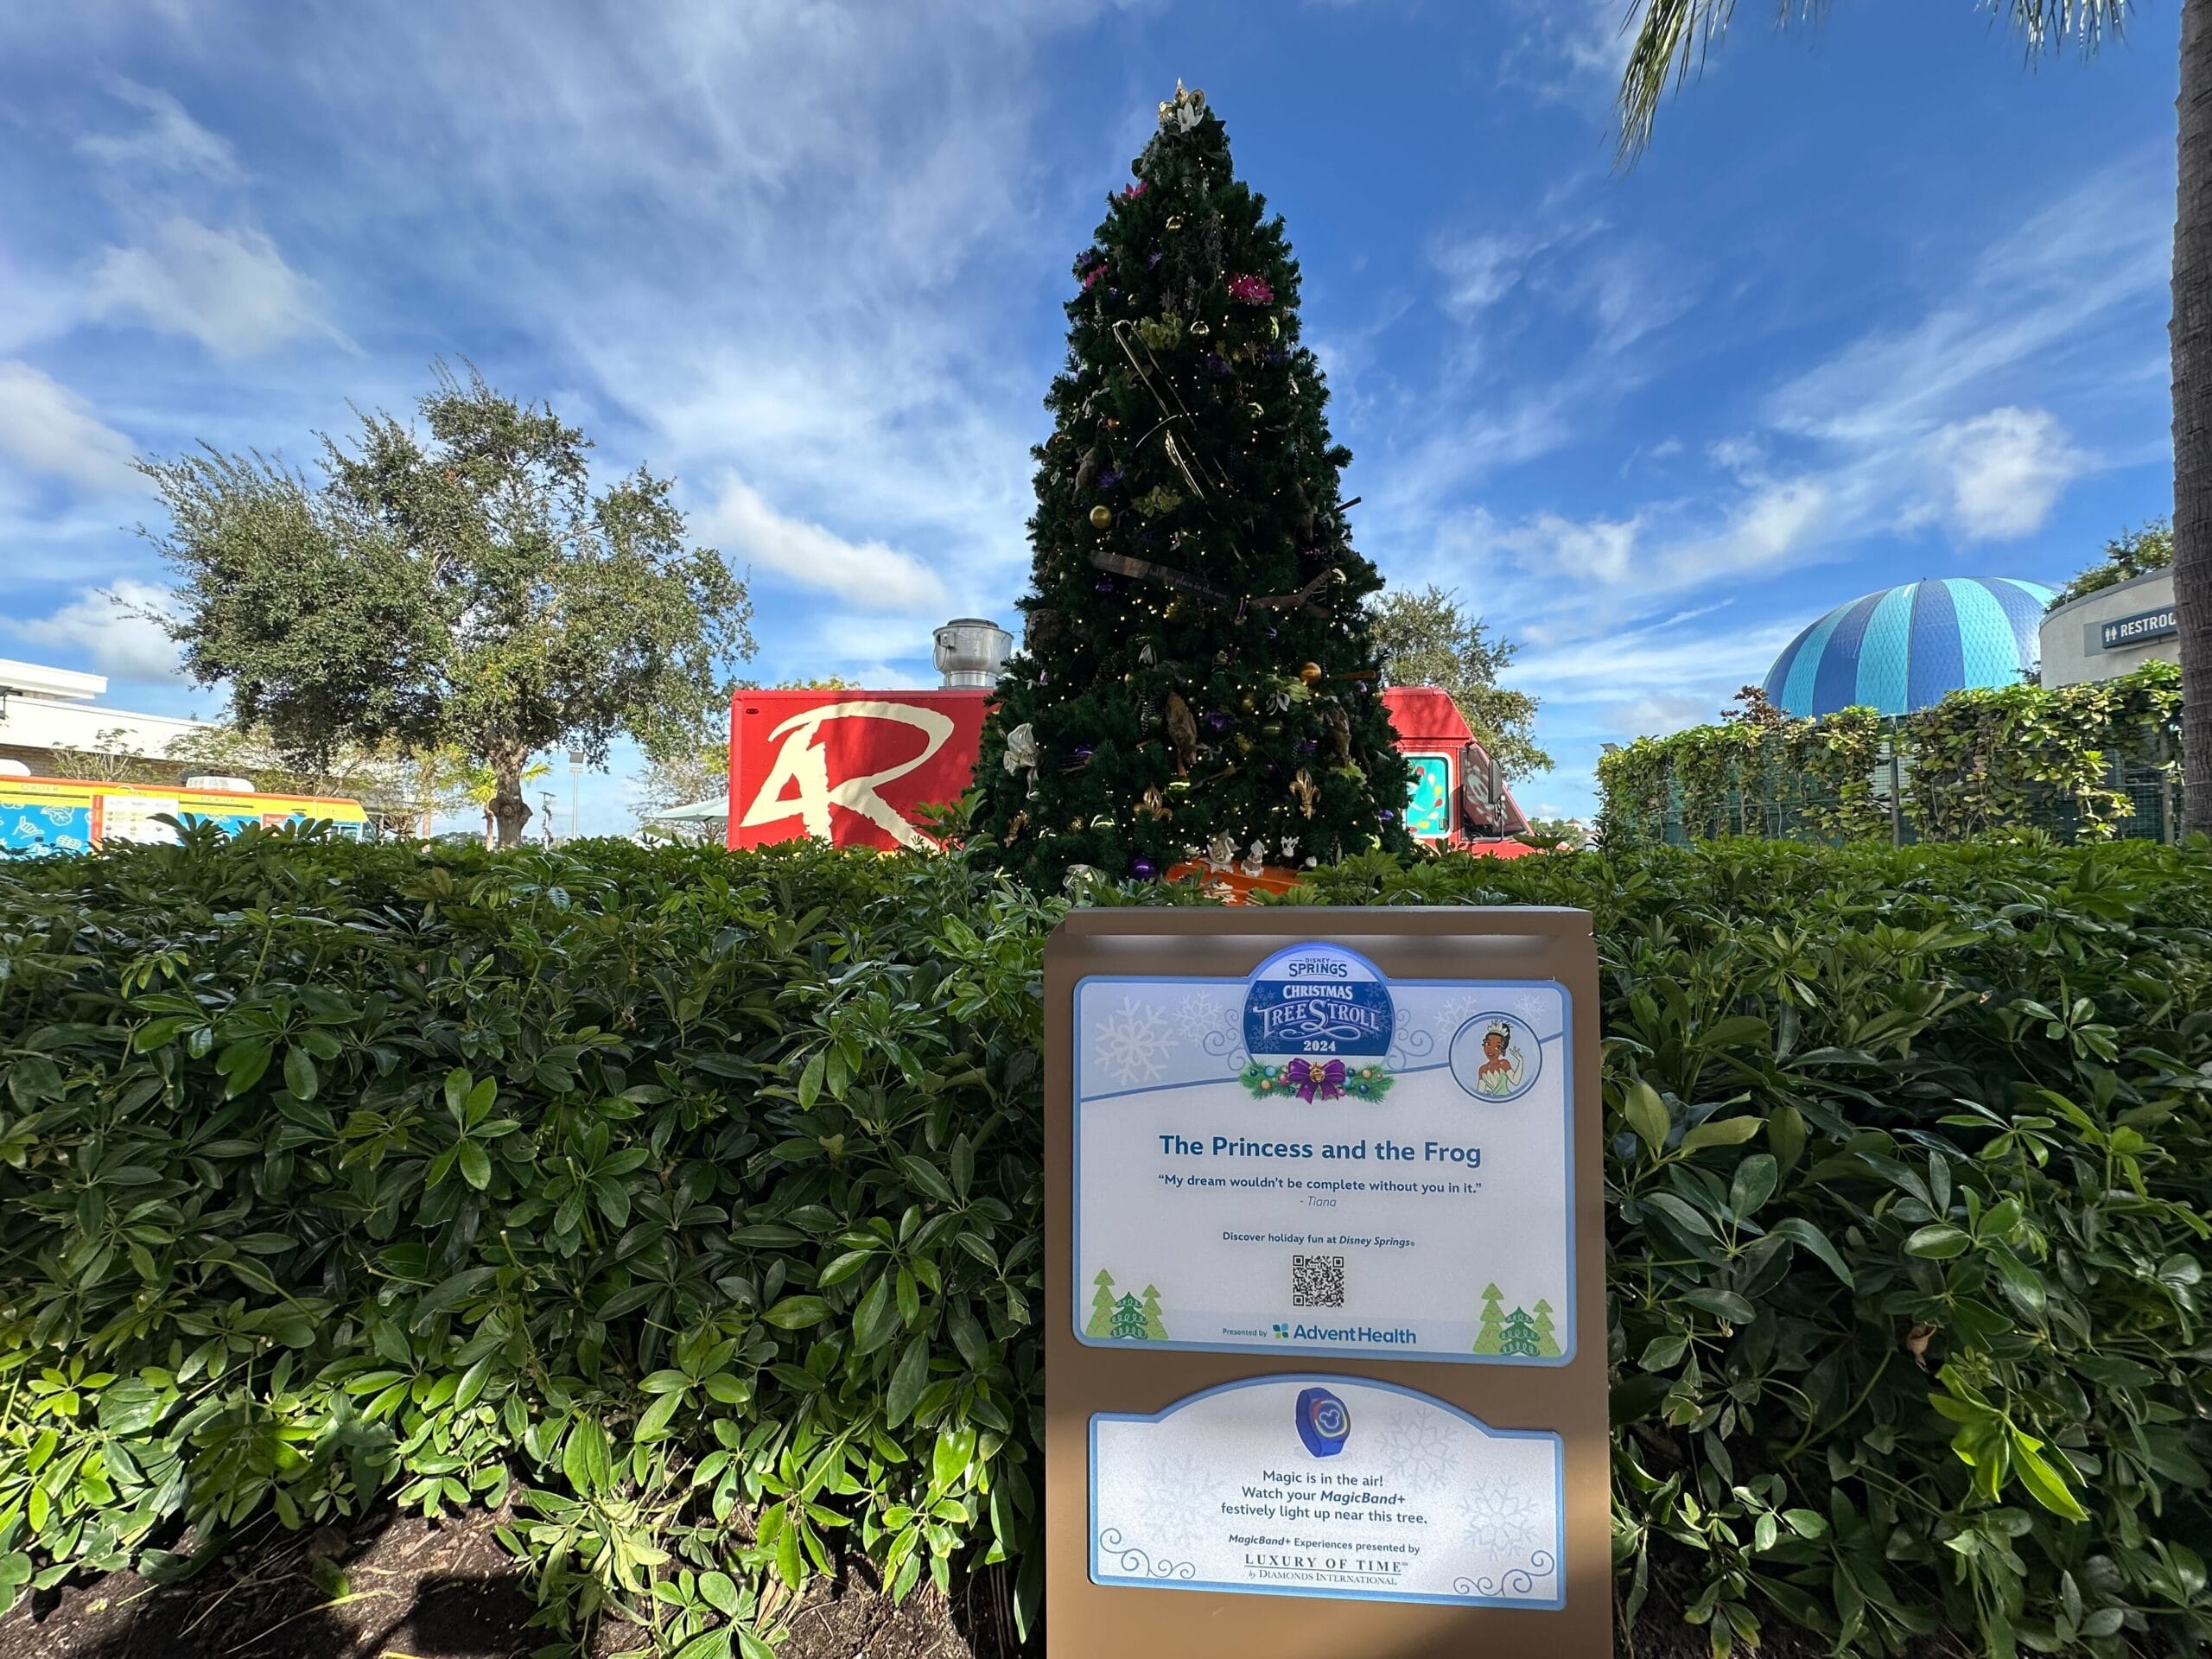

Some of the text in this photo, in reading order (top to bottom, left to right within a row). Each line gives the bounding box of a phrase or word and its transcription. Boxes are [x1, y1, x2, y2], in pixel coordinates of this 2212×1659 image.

[1288, 963, 1348, 978] SPRINGS
[1282, 984, 1353, 1001] CHRISTMAS
[1303, 1039, 1337, 1052] 2024
[1159, 1135, 1481, 1168] The Princess and the Frog
[1187, 1175, 1226, 1186] dream
[1287, 1178, 1302, 1189] be
[1306, 1179, 1365, 1192] complete
[1369, 1181, 1418, 1192] without
[1421, 1185, 1445, 1195] you
[1449, 1183, 1459, 1193] in
[1307, 1196, 1337, 1207] Tiana
[1223, 1232, 1265, 1242] Discover
[1268, 1233, 1304, 1245] holiday
[1307, 1234, 1324, 1243] fun
[1326, 1236, 1337, 1244] at
[1339, 1236, 1372, 1247] Disney
[1222, 1325, 1417, 1344] Presented by AdventHealth
[1263, 1471, 1383, 1486] Magic is in the air!
[1242, 1486, 1406, 1505] Watch your MagicBand+
[1221, 1503, 1427, 1523] festively light up near this tree.
[1229, 1534, 1420, 1555] MagicBand+ Experiences presented by
[1245, 1554, 1317, 1567] LUXURY
[1325, 1558, 1348, 1569] OF
[1249, 1569, 1397, 1585] by DIAMONDS INTERNATIONAL
